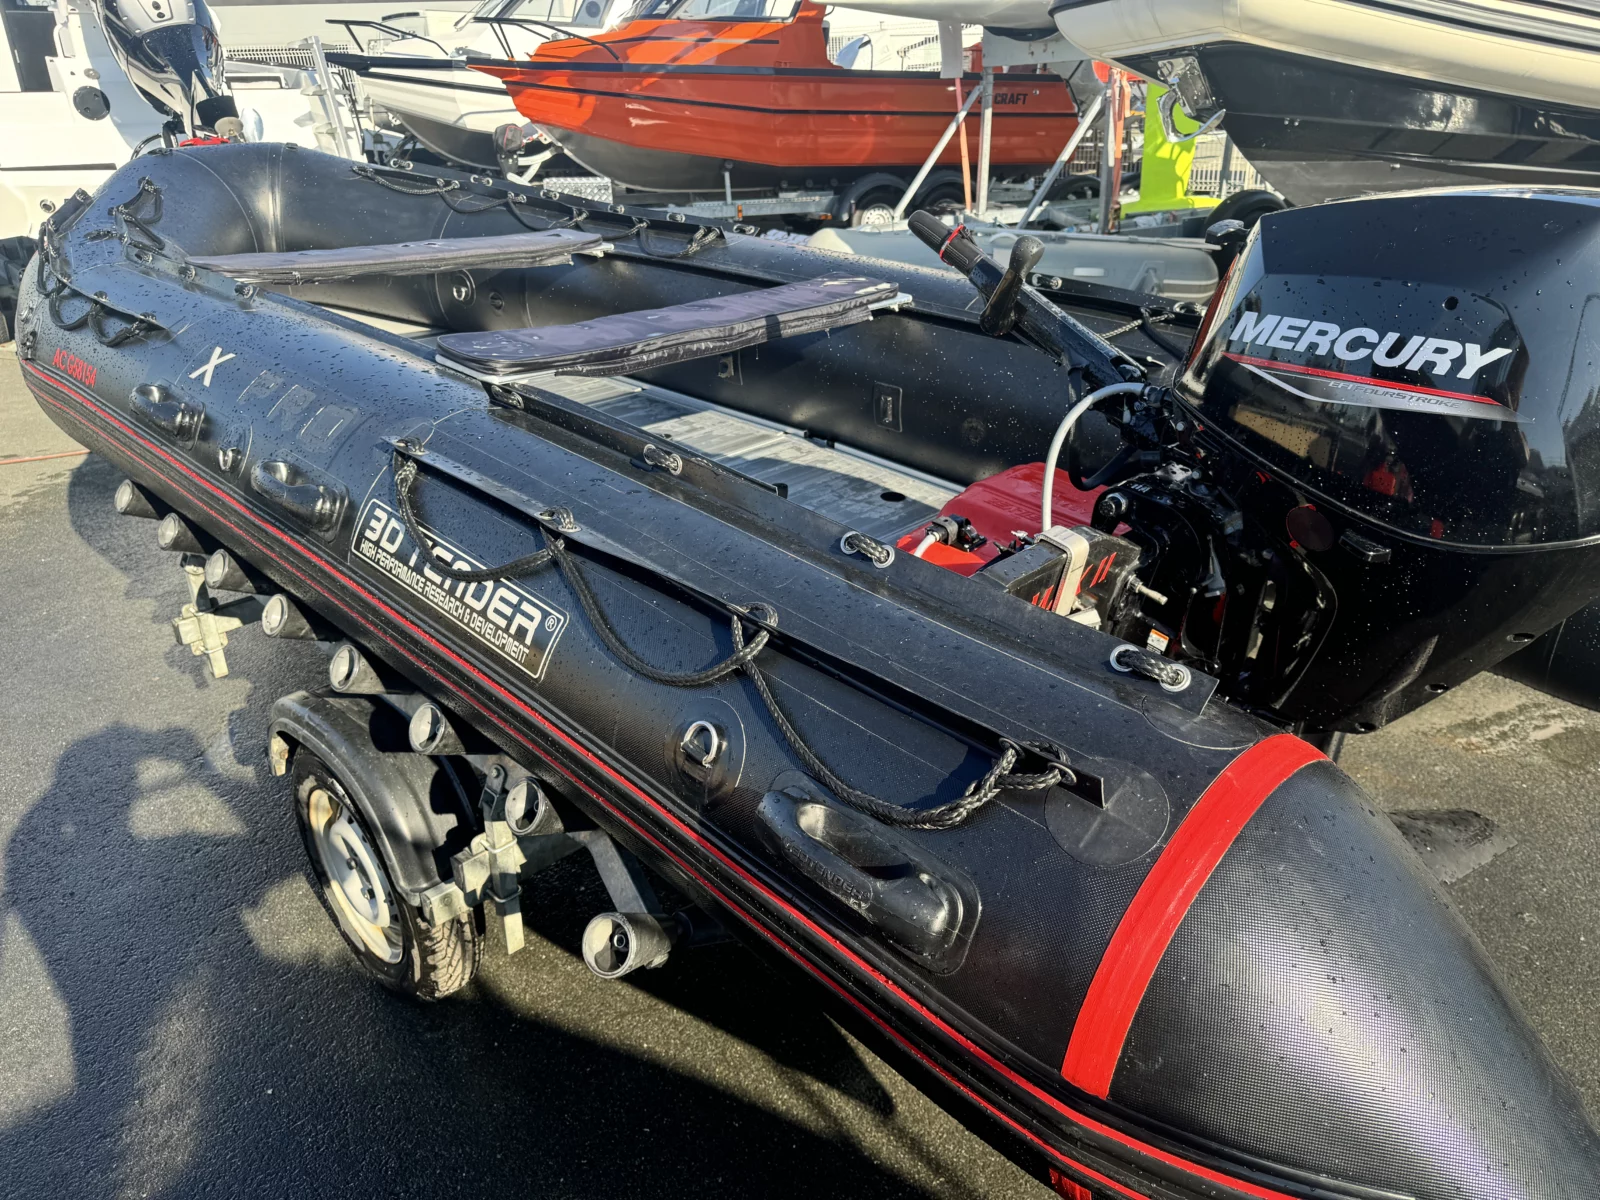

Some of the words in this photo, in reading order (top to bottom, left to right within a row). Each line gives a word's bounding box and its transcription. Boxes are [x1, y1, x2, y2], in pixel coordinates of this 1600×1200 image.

[52, 347, 67, 371] AC
[188, 346, 237, 388] X
[1229, 311, 1513, 380] MERCURY
[364, 507, 406, 554] 3D
[359, 538, 377, 561] HIGH
[375, 547, 425, 592] PERFORMANCE
[424, 581, 466, 619] RESEARCH
[464, 609, 471, 623] &
[469, 613, 530, 664] DEVELOPMENT
